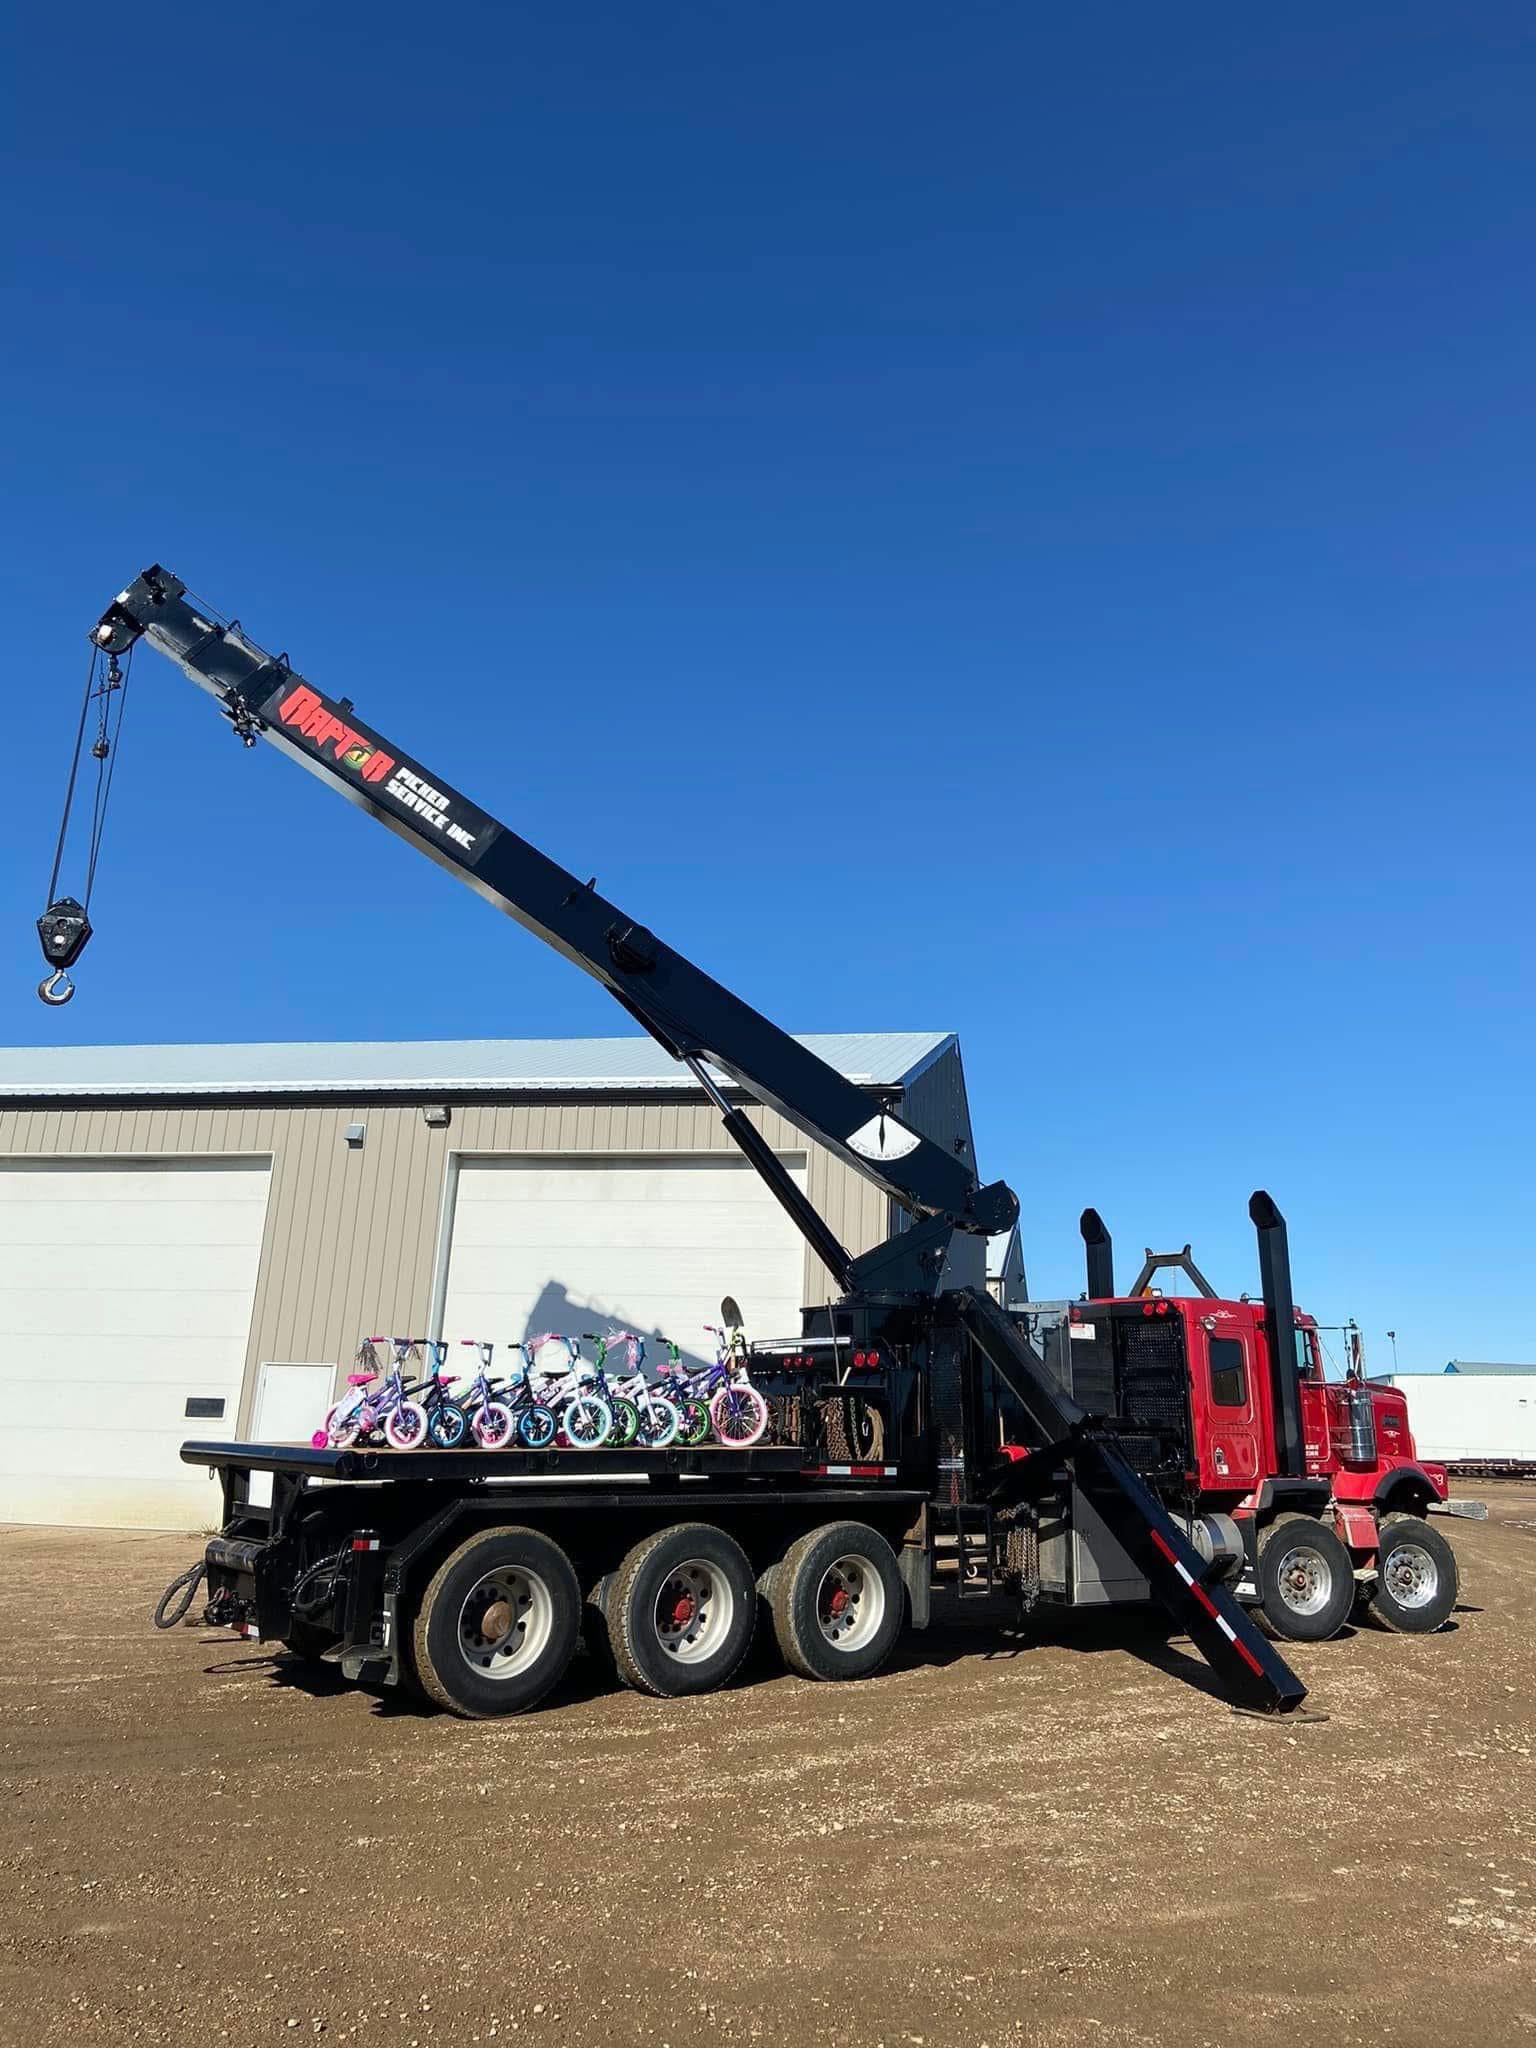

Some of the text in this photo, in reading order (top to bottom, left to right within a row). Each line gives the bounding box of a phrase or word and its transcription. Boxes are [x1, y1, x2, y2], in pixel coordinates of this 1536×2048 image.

[385, 778, 476, 850] SERVICE INC
[395, 766, 450, 811] PICKER
